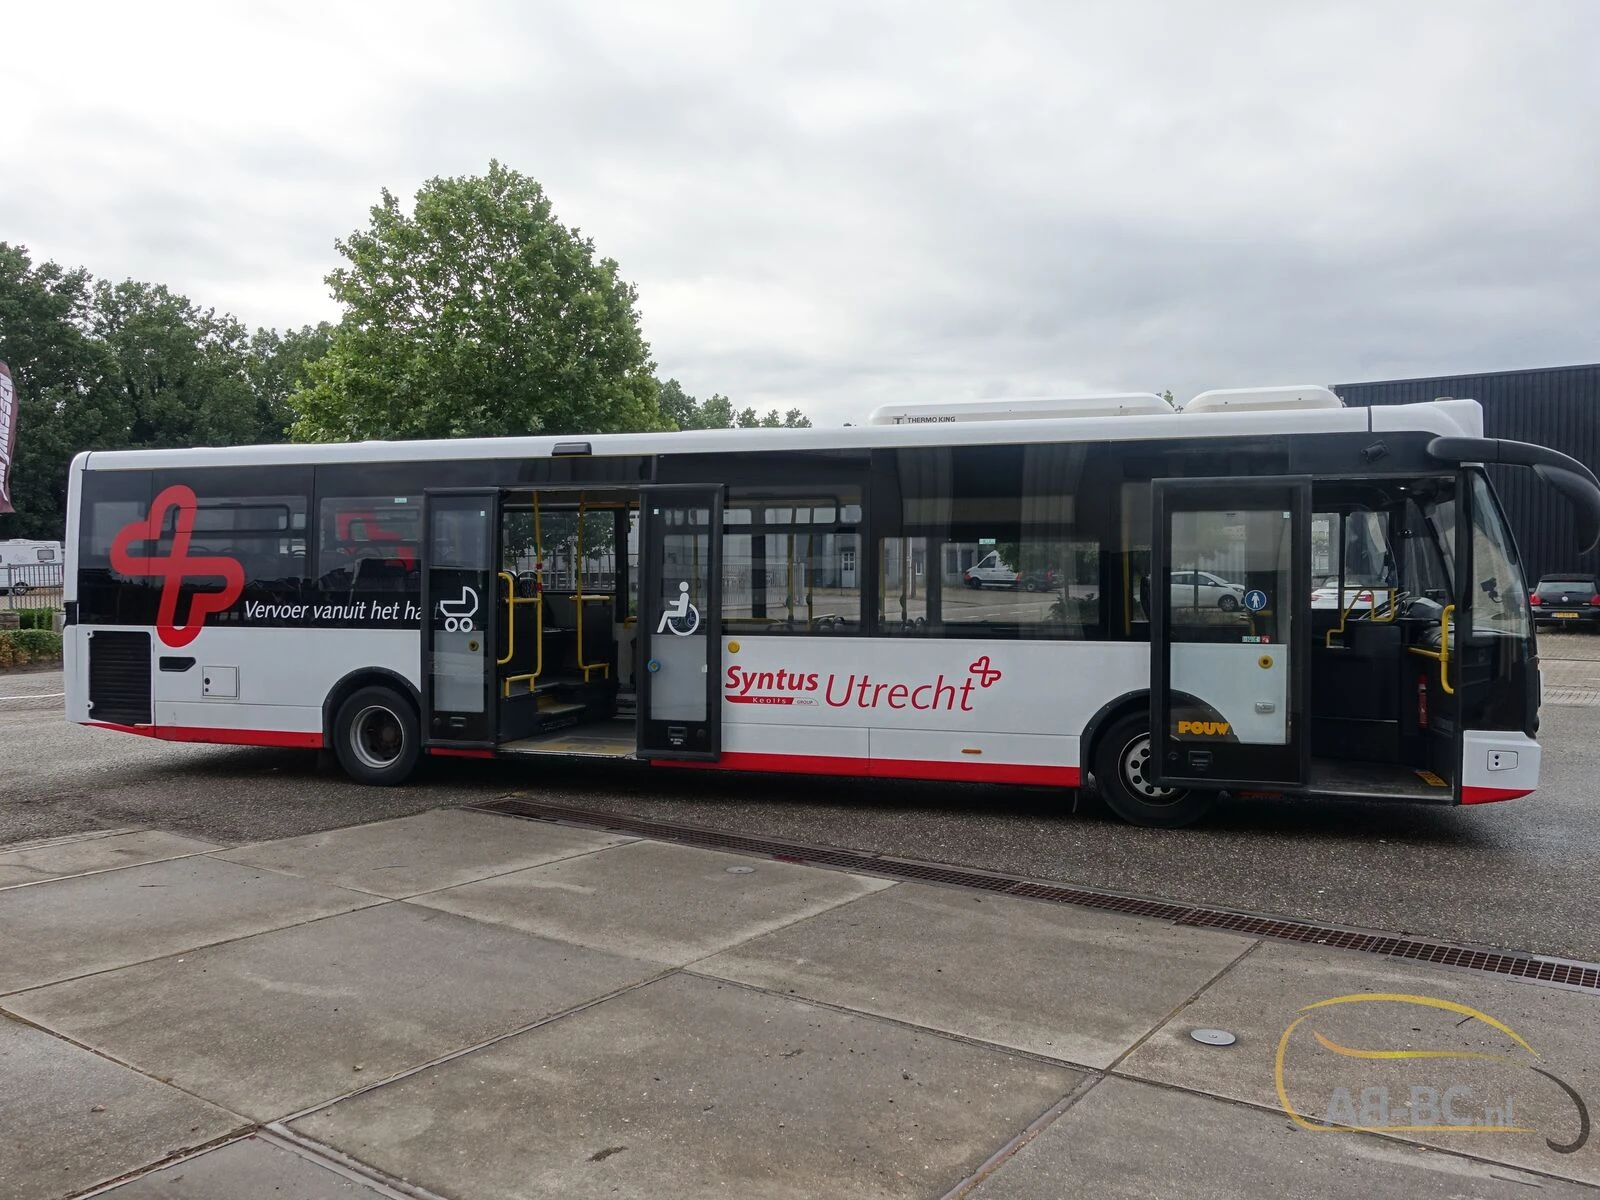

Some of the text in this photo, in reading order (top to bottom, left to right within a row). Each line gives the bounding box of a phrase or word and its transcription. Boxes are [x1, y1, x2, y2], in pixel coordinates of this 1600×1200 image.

[245, 600, 308, 618] Vervoer
[313, 601, 365, 619] vanuit
[370, 601, 399, 620] het
[725, 665, 975, 711] Syntus Utrecht
[1178, 721, 1230, 736] POUW
